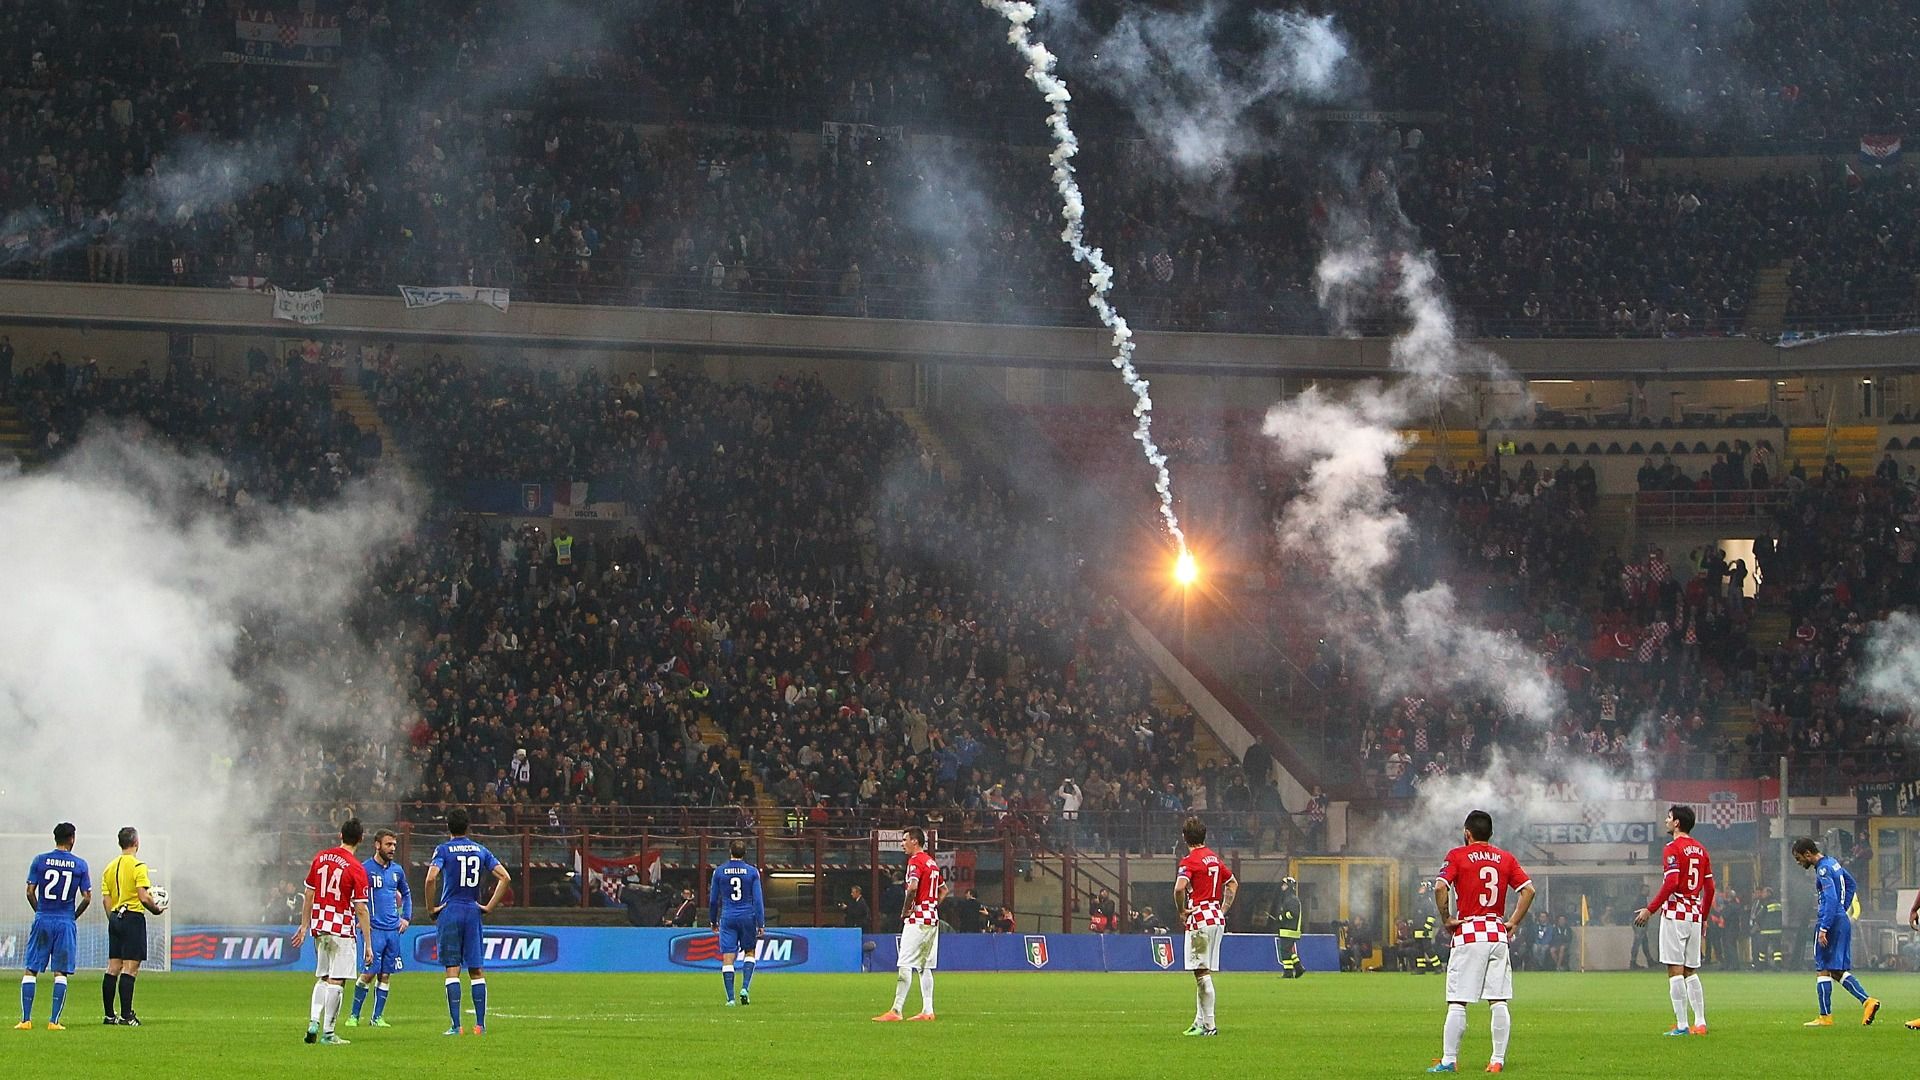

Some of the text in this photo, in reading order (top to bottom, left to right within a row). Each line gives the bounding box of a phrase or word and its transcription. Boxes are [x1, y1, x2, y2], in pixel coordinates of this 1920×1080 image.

[1532, 823, 1654, 843] BERAVCI
[45, 869, 72, 900] 21
[317, 864, 343, 901] 14
[372, 875, 382, 888] 16
[457, 856, 480, 887] 13
[929, 869, 940, 899] 17
[1208, 866, 1219, 898] 7
[1479, 866, 1498, 907] 3
[1688, 858, 1699, 890] 5
[730, 877, 742, 901] 3
[222, 937, 283, 960] TIM
[395, 956, 402, 969] 16
[483, 938, 541, 960] TIM
